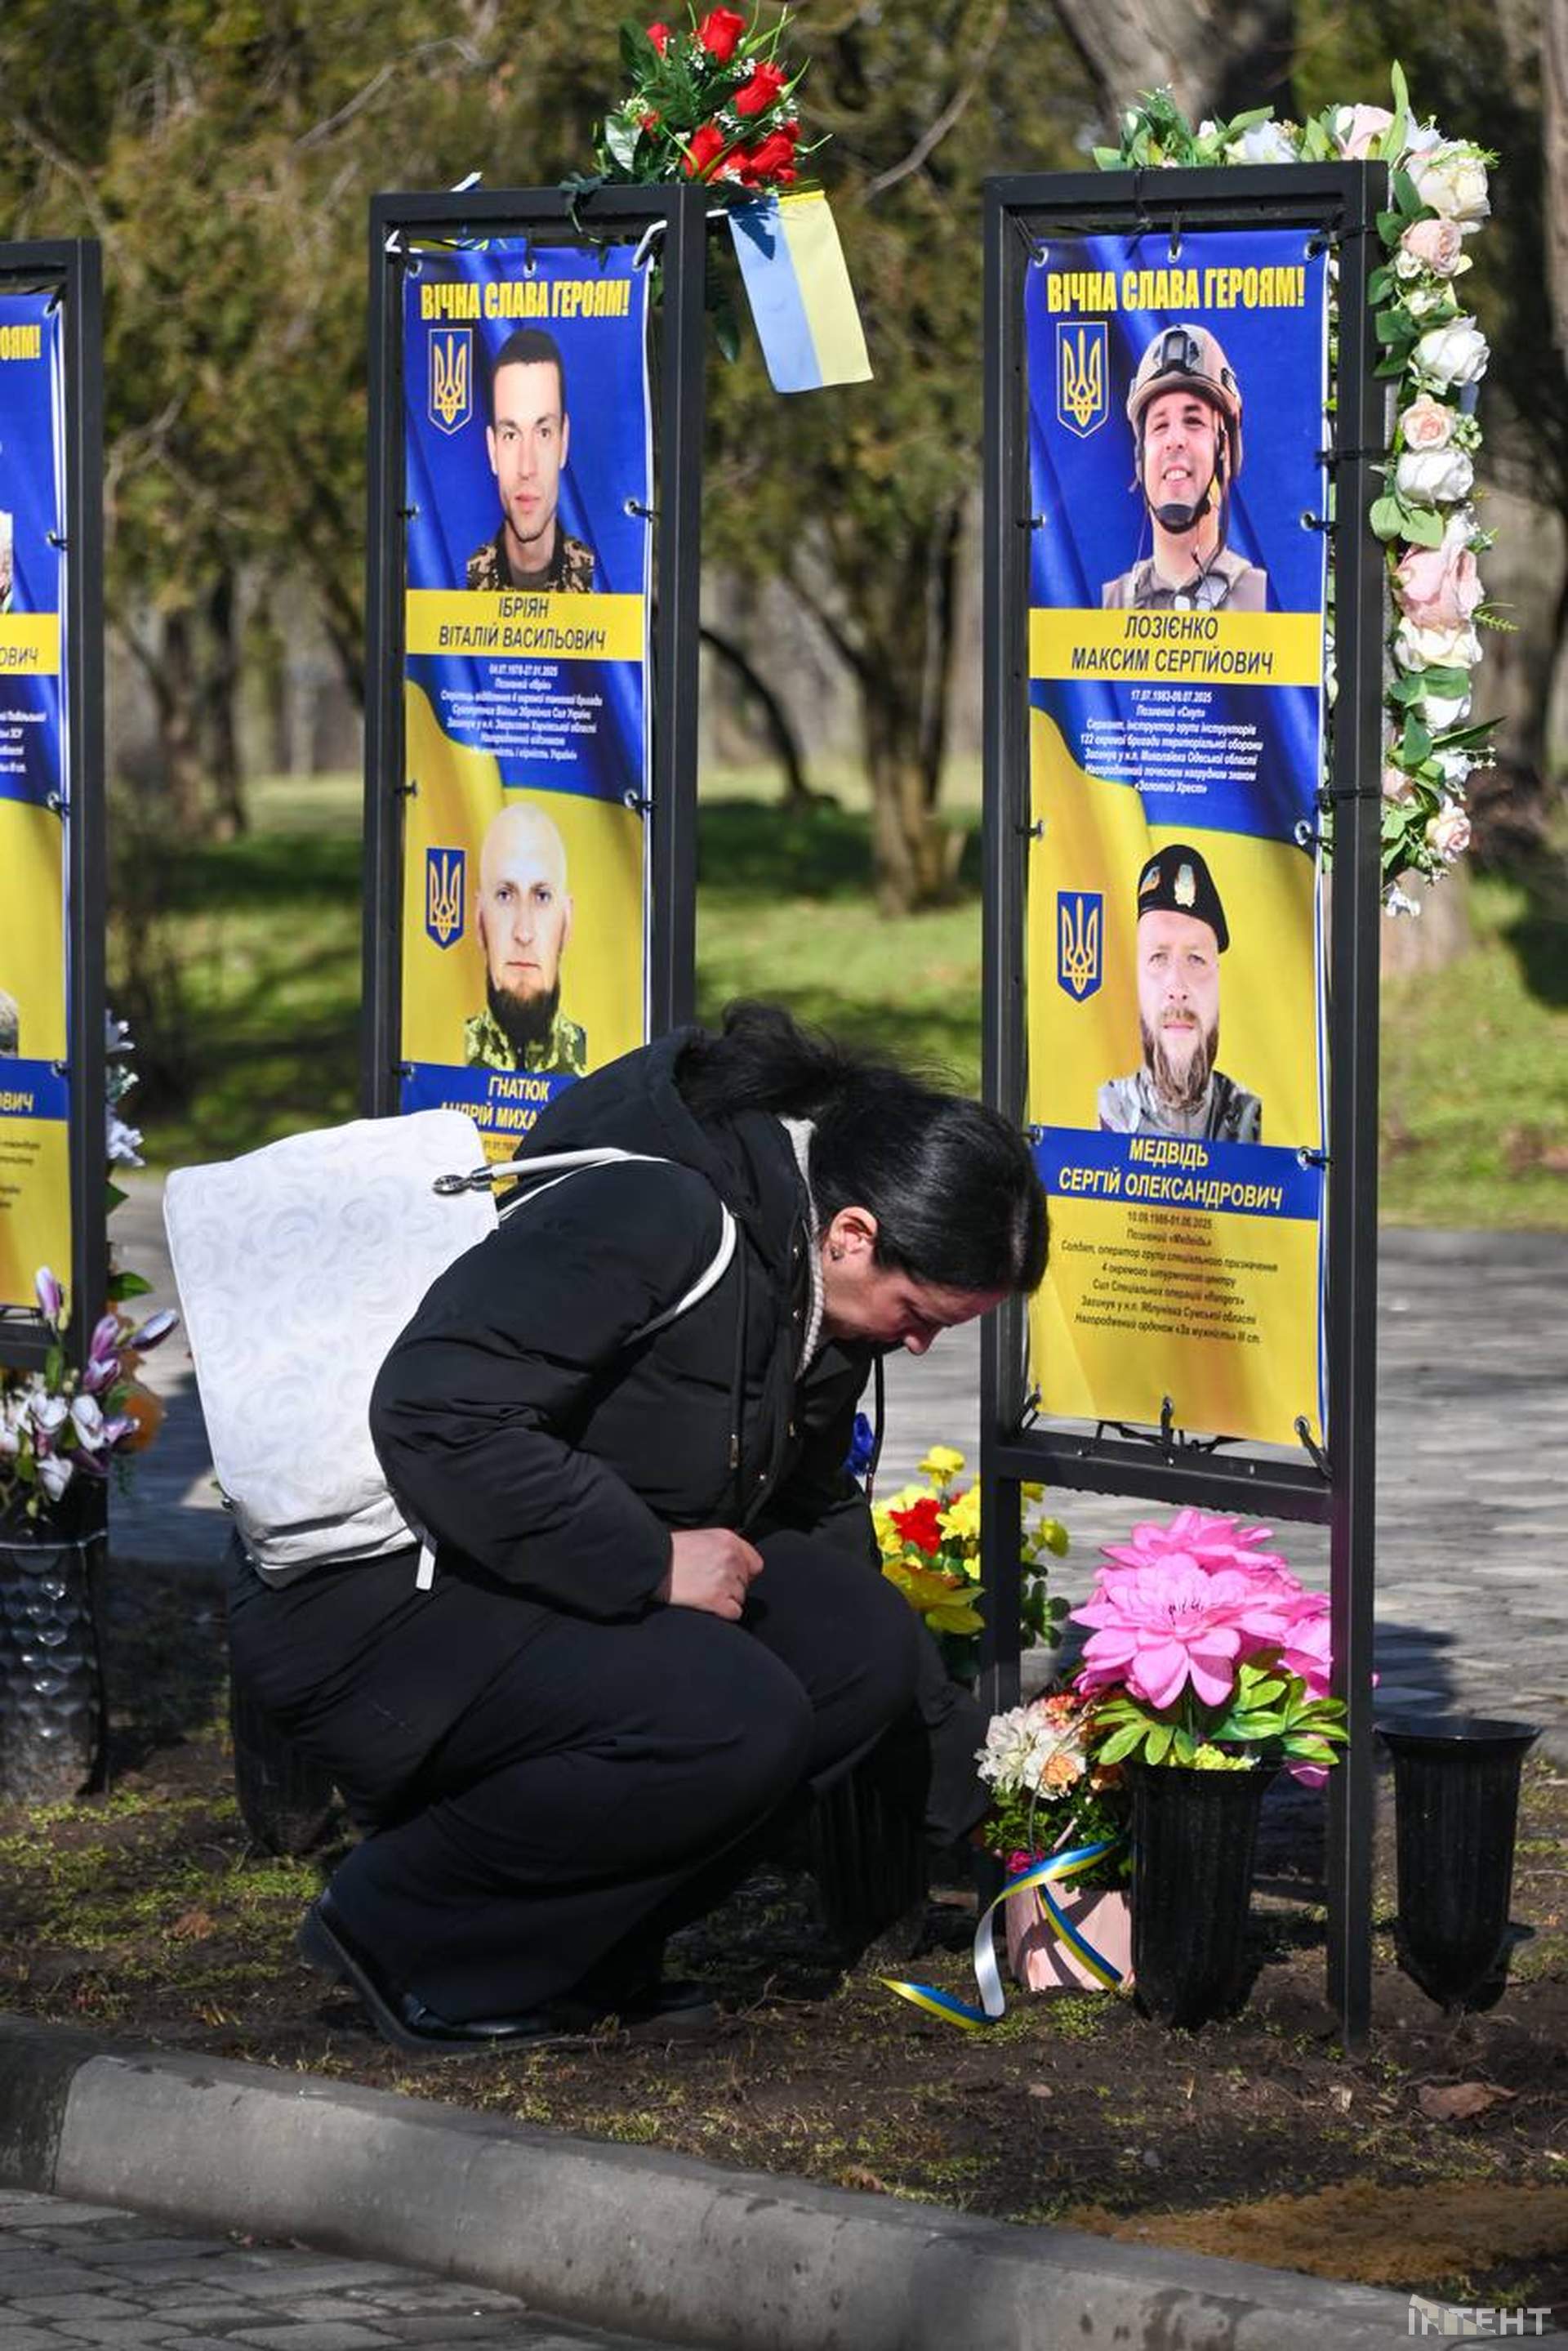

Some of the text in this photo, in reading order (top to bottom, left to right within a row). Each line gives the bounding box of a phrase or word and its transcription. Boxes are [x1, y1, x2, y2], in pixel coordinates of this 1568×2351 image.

[421, 280, 631, 319] ВІЧНА СЛАВА ГЕРОЯМ!
[1047, 265, 1305, 313] ВІЧНА СЛАВА ГЕРОЯМ!
[498, 597, 550, 618] ІБРІЯН
[439, 622, 607, 651] ВІТАЛІЙ ВАСИЛЬОВИЧ
[1124, 614, 1219, 640] ЛОЗІЄНКО
[1071, 644, 1274, 676] МАКСИМ СЕРГІЙОВИЧ
[488, 1076, 550, 1103] ГНАТЮК
[1129, 1137, 1209, 1171] МЕДВІДЬ
[1058, 1167, 1283, 1211] СЕРГІЙ ОЛЕКСАНДРОВИЧ
